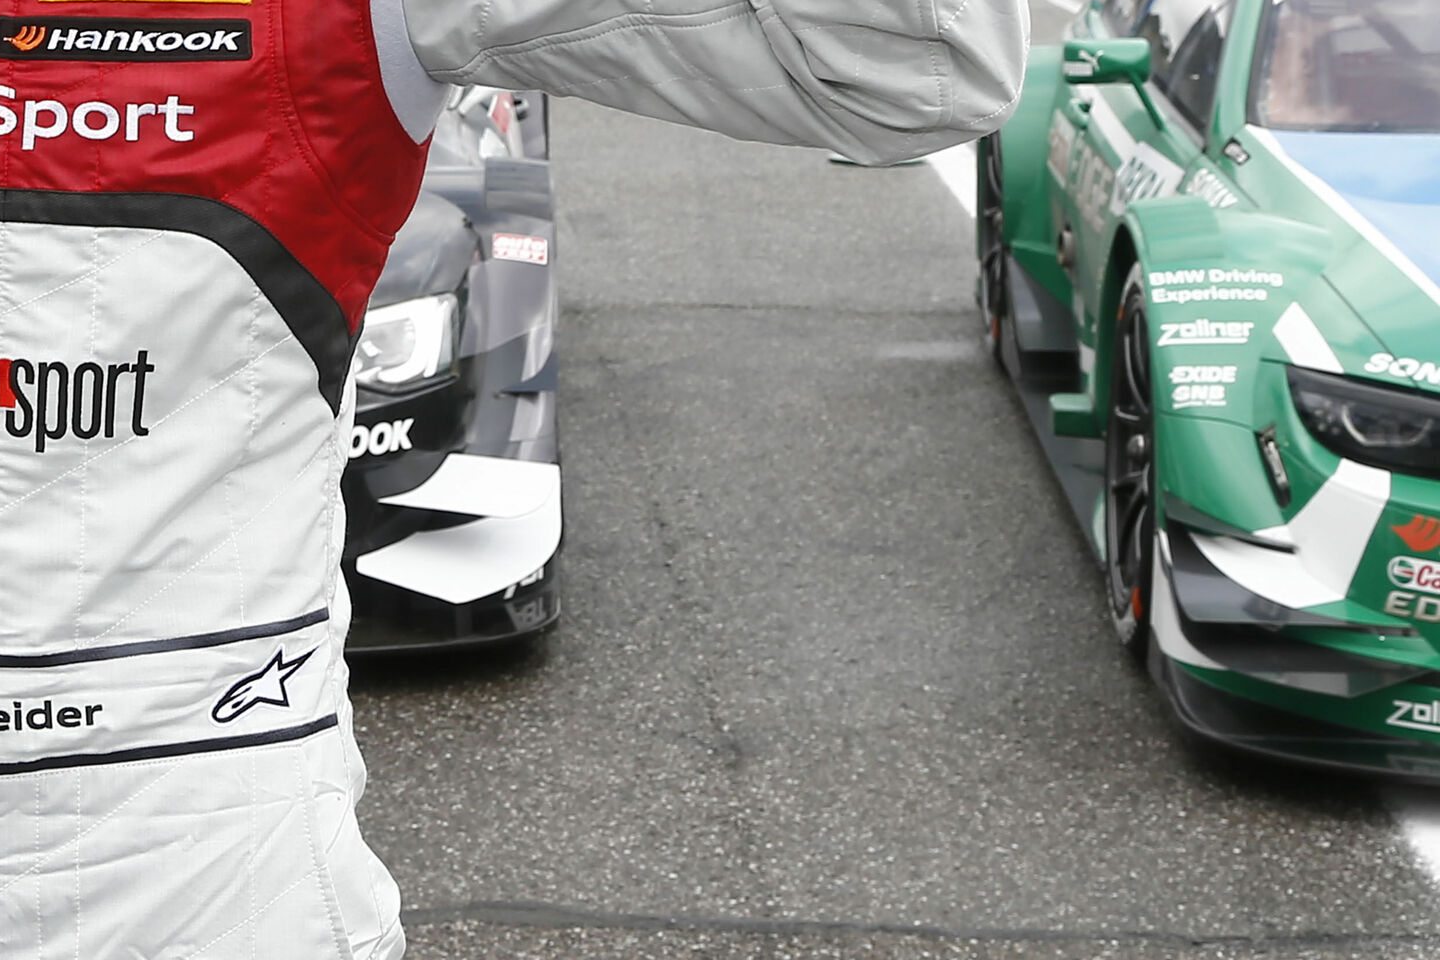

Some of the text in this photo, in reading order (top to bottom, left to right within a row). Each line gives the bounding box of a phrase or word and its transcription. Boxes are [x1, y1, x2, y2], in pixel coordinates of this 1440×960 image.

[1148, 268, 1284, 287] BMW Driving
[1150, 285, 1268, 304] Experience
